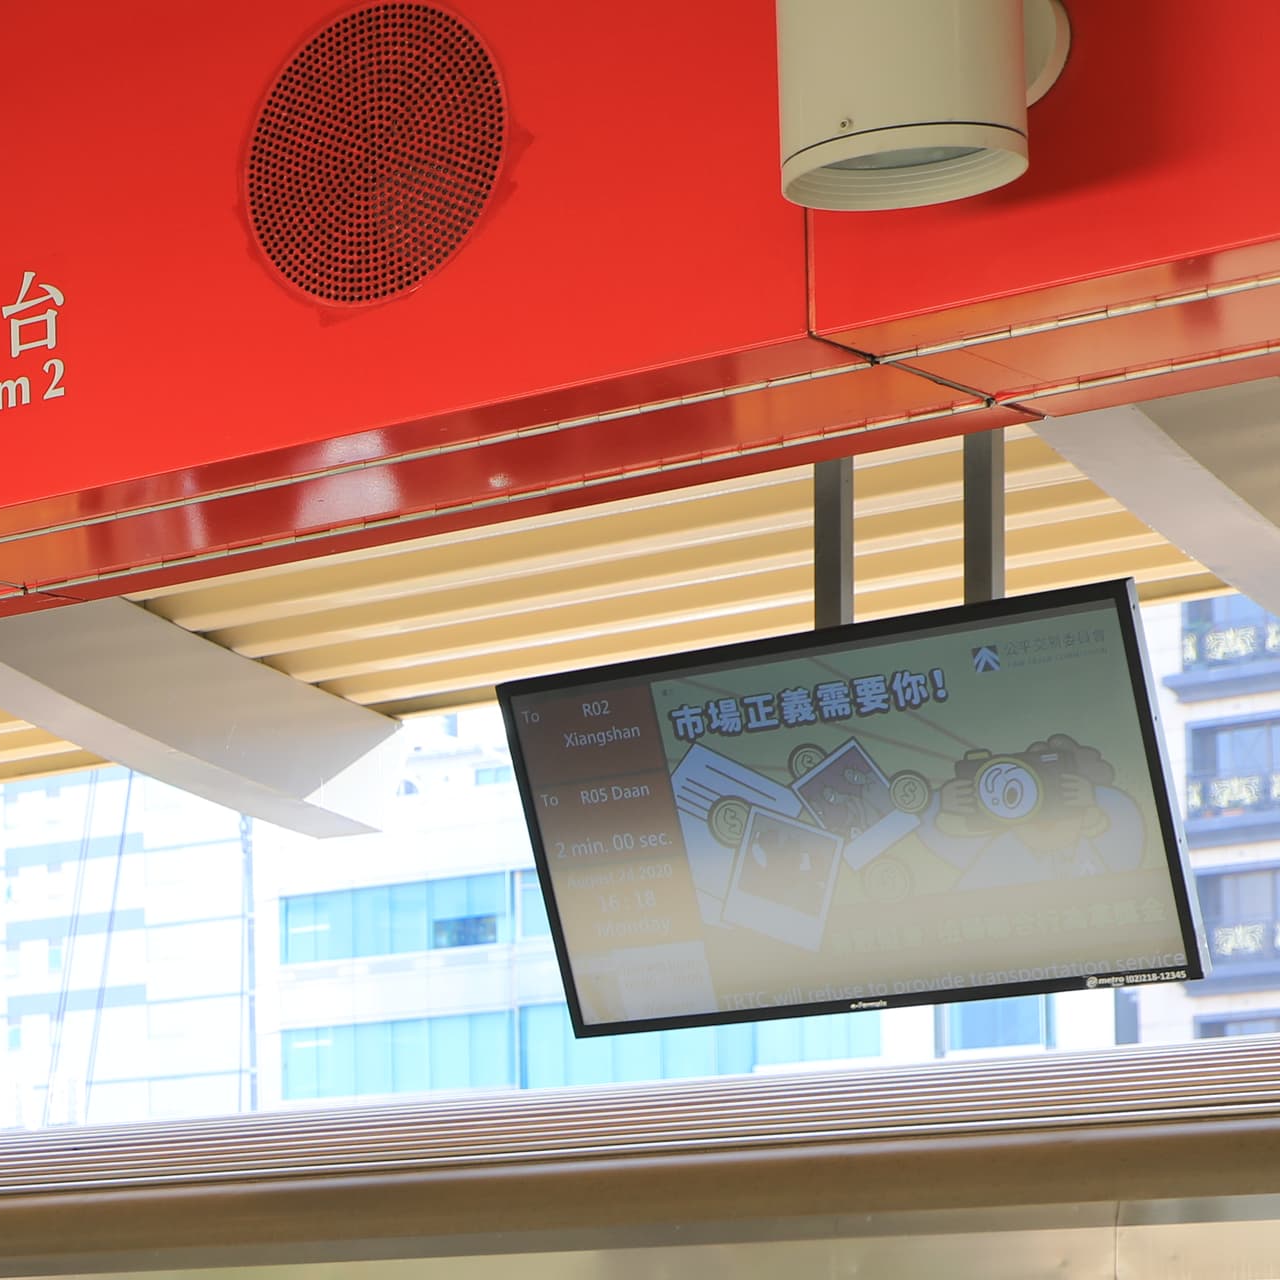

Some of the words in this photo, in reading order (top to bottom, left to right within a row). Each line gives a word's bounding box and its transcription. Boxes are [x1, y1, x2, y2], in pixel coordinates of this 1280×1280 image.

[42, 359, 66, 401] 2
[521, 711, 540, 724] To
[582, 700, 610, 717] R02
[563, 725, 640, 747] Xiangshan
[541, 794, 559, 808] To
[580, 788, 608, 805] R05
[612, 785, 650, 800] Daan
[555, 842, 567, 859] 2
[572, 837, 608, 856] min.
[612, 833, 634, 851] 00
[640, 832, 673, 847] sec.
[809, 983, 865, 1001] refuse
[869, 981, 888, 996] to
[893, 971, 964, 996] provide
[970, 956, 1111, 985] transportation
[1115, 951, 1186, 971] service
